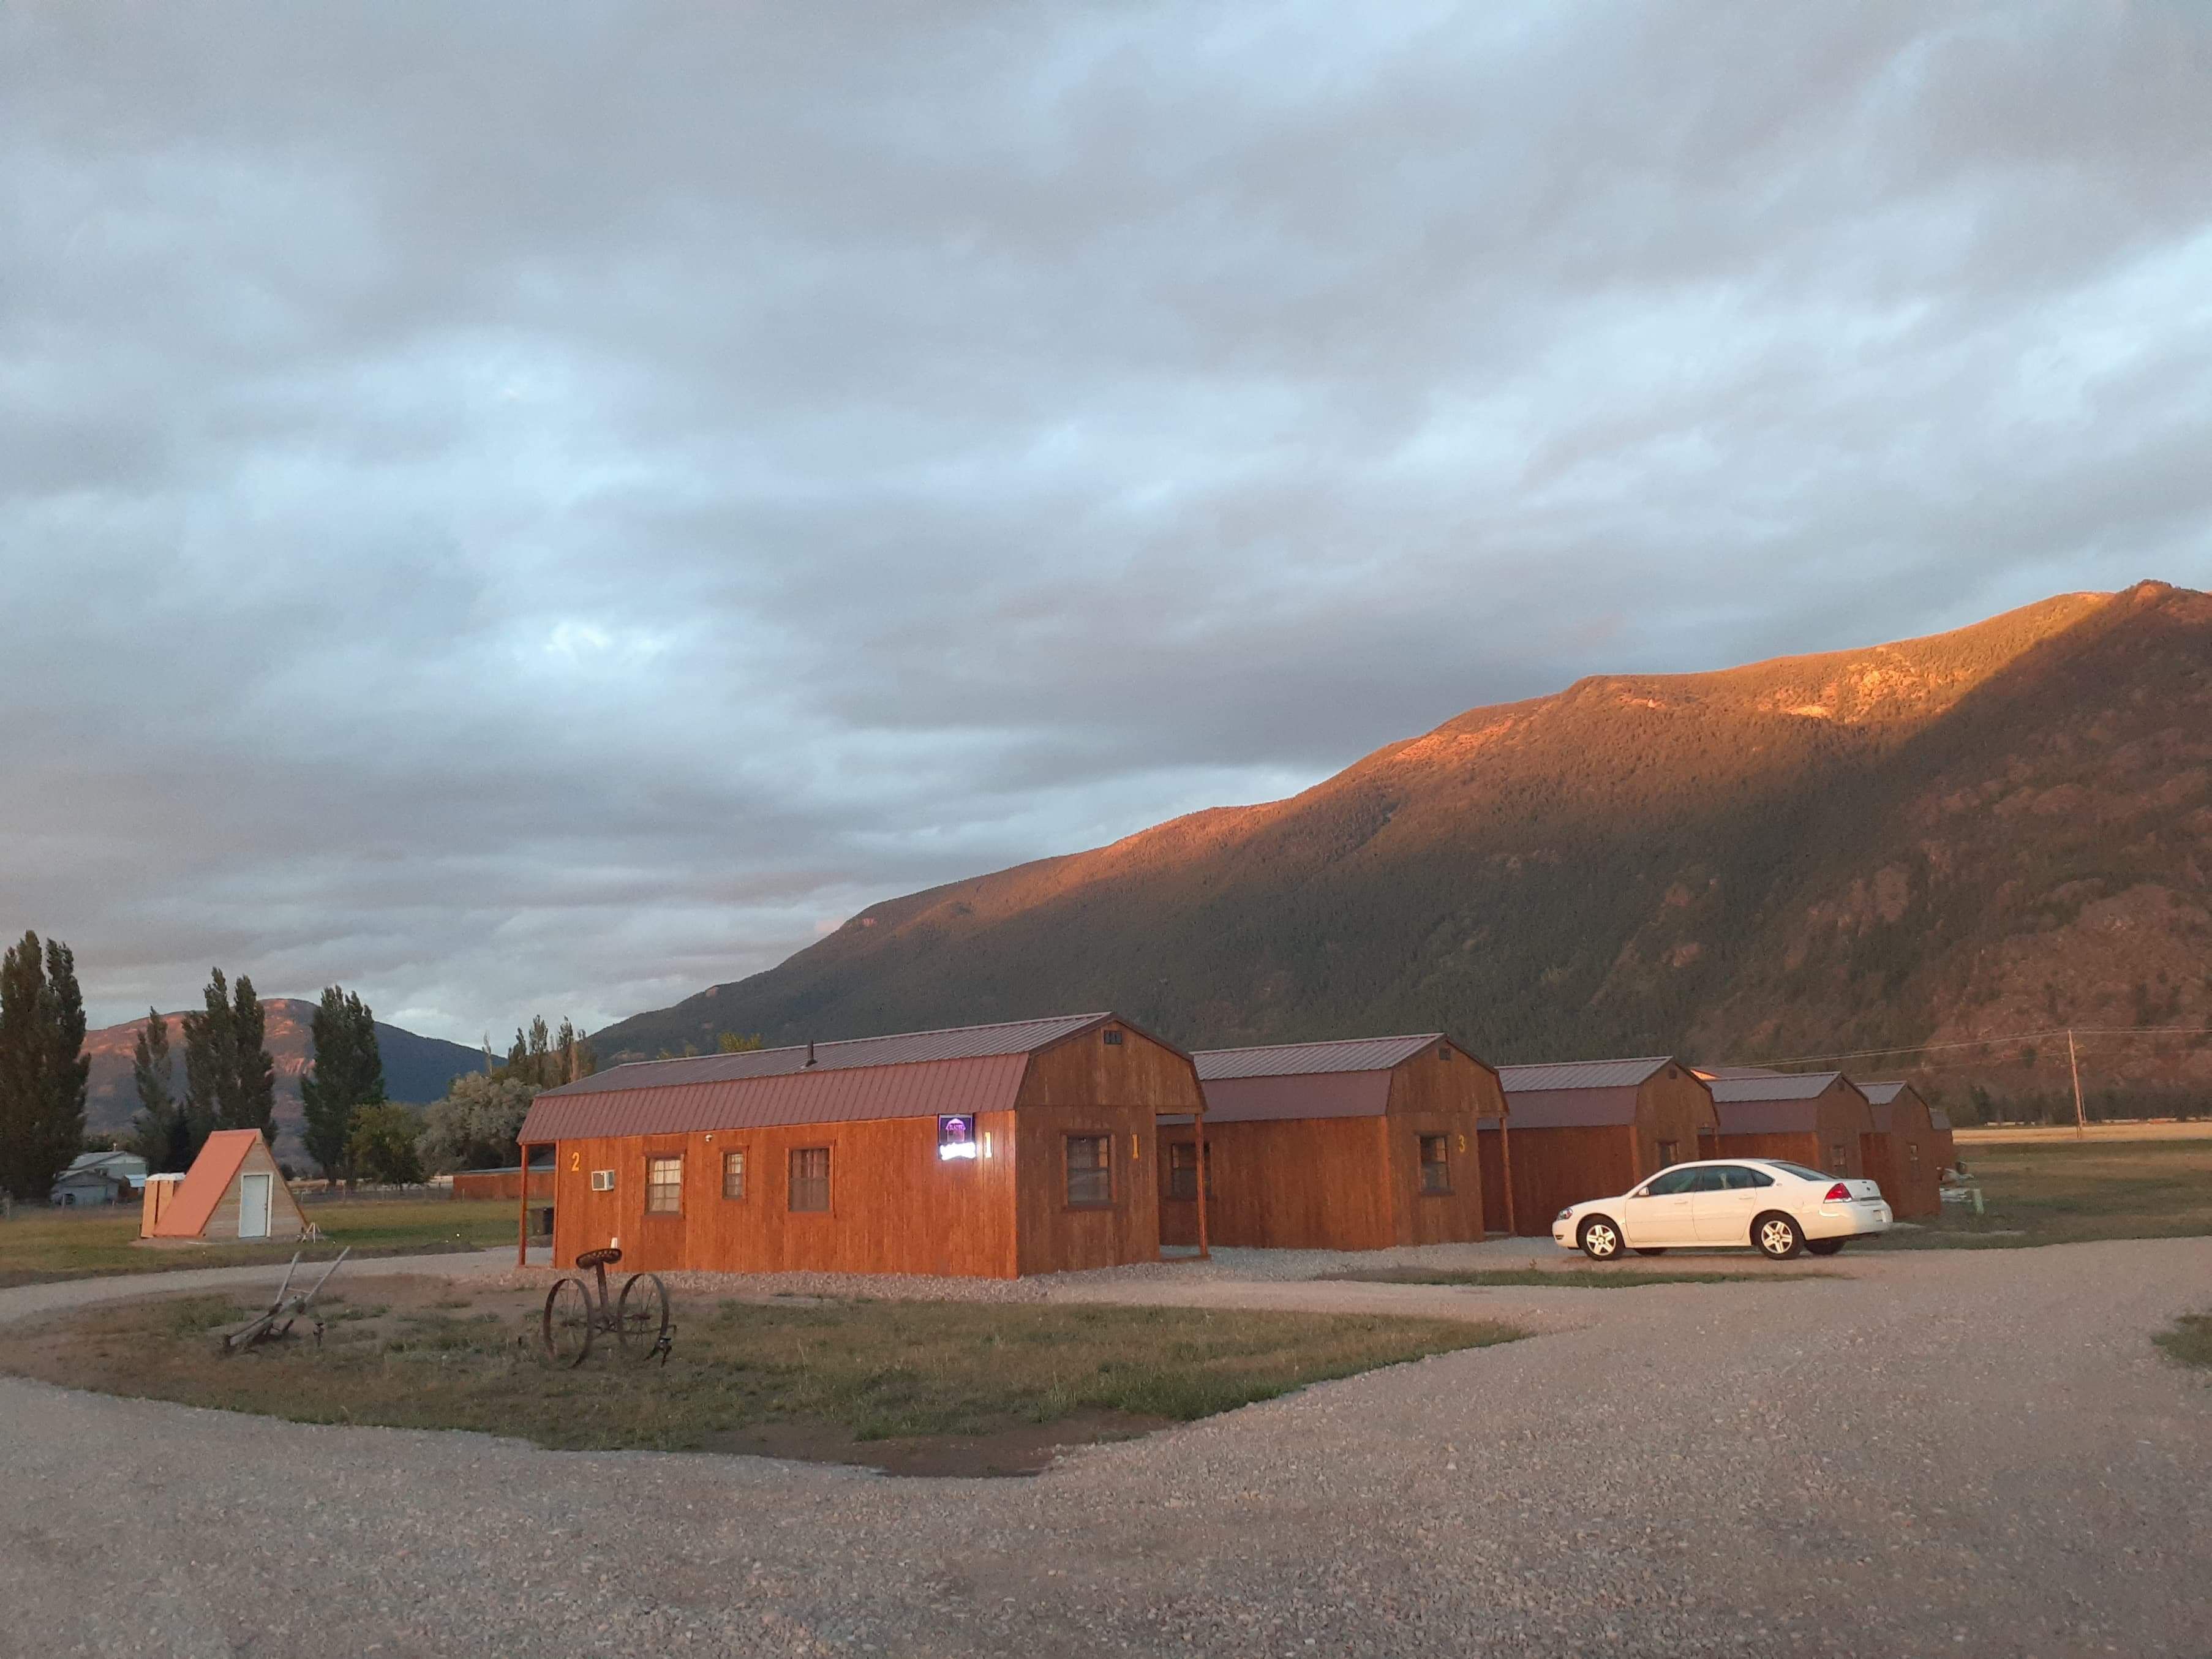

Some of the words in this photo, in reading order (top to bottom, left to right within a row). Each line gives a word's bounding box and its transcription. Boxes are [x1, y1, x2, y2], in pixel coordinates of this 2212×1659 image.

[1132, 1134, 1138, 1159] 1
[1459, 1135, 1465, 1153] 3
[571, 1152, 579, 1172] 2
